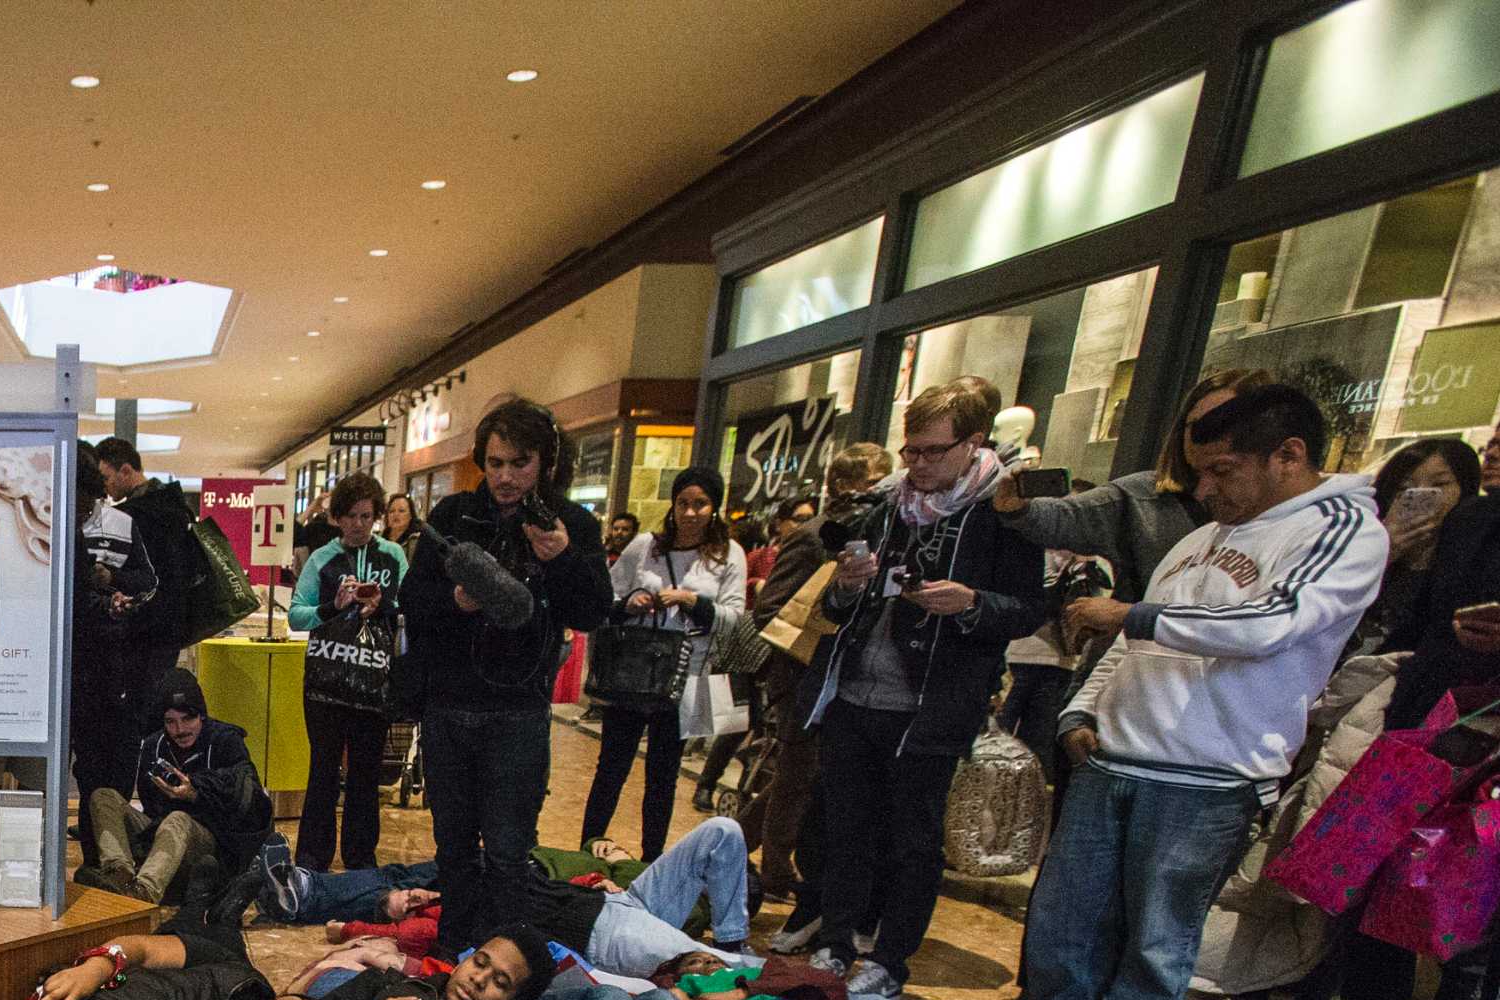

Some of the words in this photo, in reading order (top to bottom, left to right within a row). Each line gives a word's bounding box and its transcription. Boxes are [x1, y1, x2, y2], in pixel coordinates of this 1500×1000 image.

[333, 431, 359, 441] west
[363, 430, 384, 441] elm
[255, 504, 285, 548] T
[339, 562, 391, 588] nke
[1, 648, 33, 659] GIFT.
